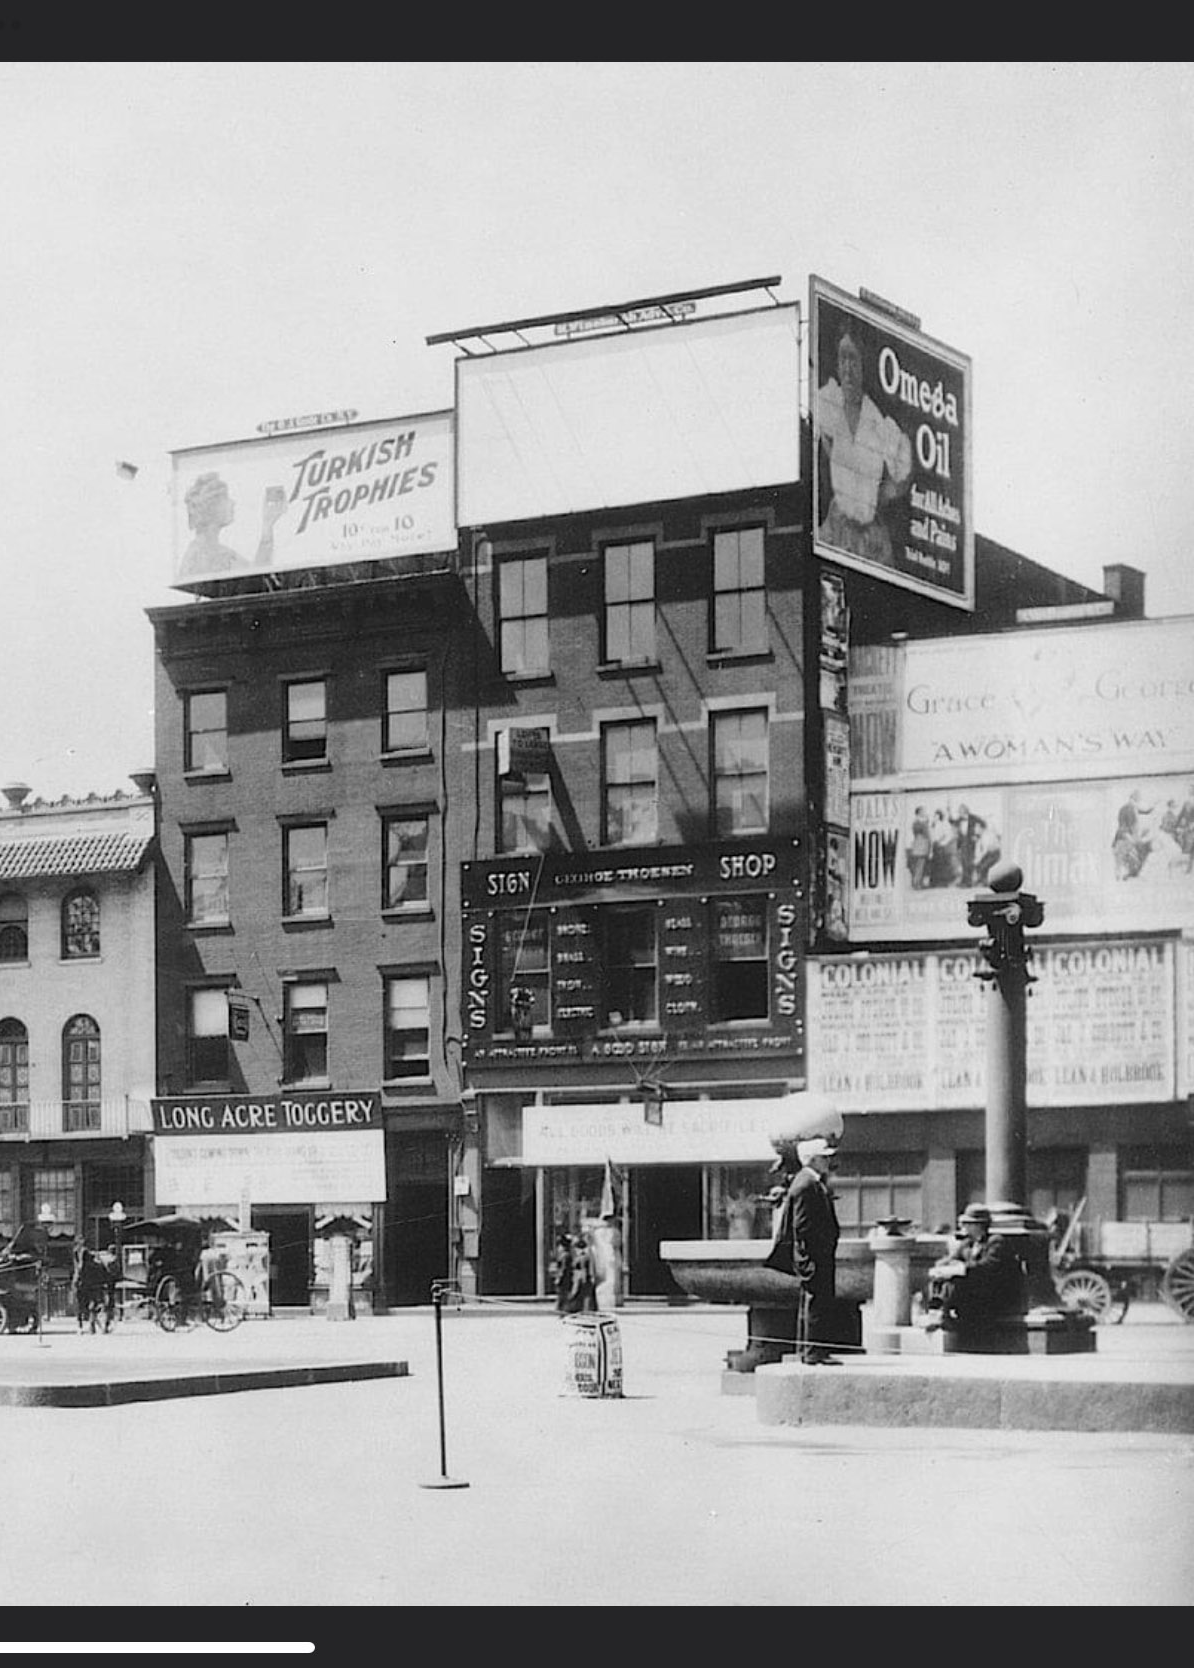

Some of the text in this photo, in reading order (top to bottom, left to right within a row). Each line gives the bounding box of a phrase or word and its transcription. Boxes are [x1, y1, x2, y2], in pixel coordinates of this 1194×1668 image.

[878, 346, 959, 426] Omega
[288, 430, 417, 504] TURKISH
[916, 423, 950, 478] Oil
[294, 461, 439, 536] TROPHIES
[395, 514, 414, 531] 10
[487, 872, 530, 895] SIGN
[719, 854, 776, 879] SHOP
[854, 828, 899, 890] NOW
[468, 923, 490, 1029] SIGNS
[775, 904, 800, 1016] SIGNS
[820, 960, 925, 988] COLONIAL
[1054, 945, 1166, 978] COLONIAL
[159, 1100, 374, 1130] LONG ACRE TOGGERY
